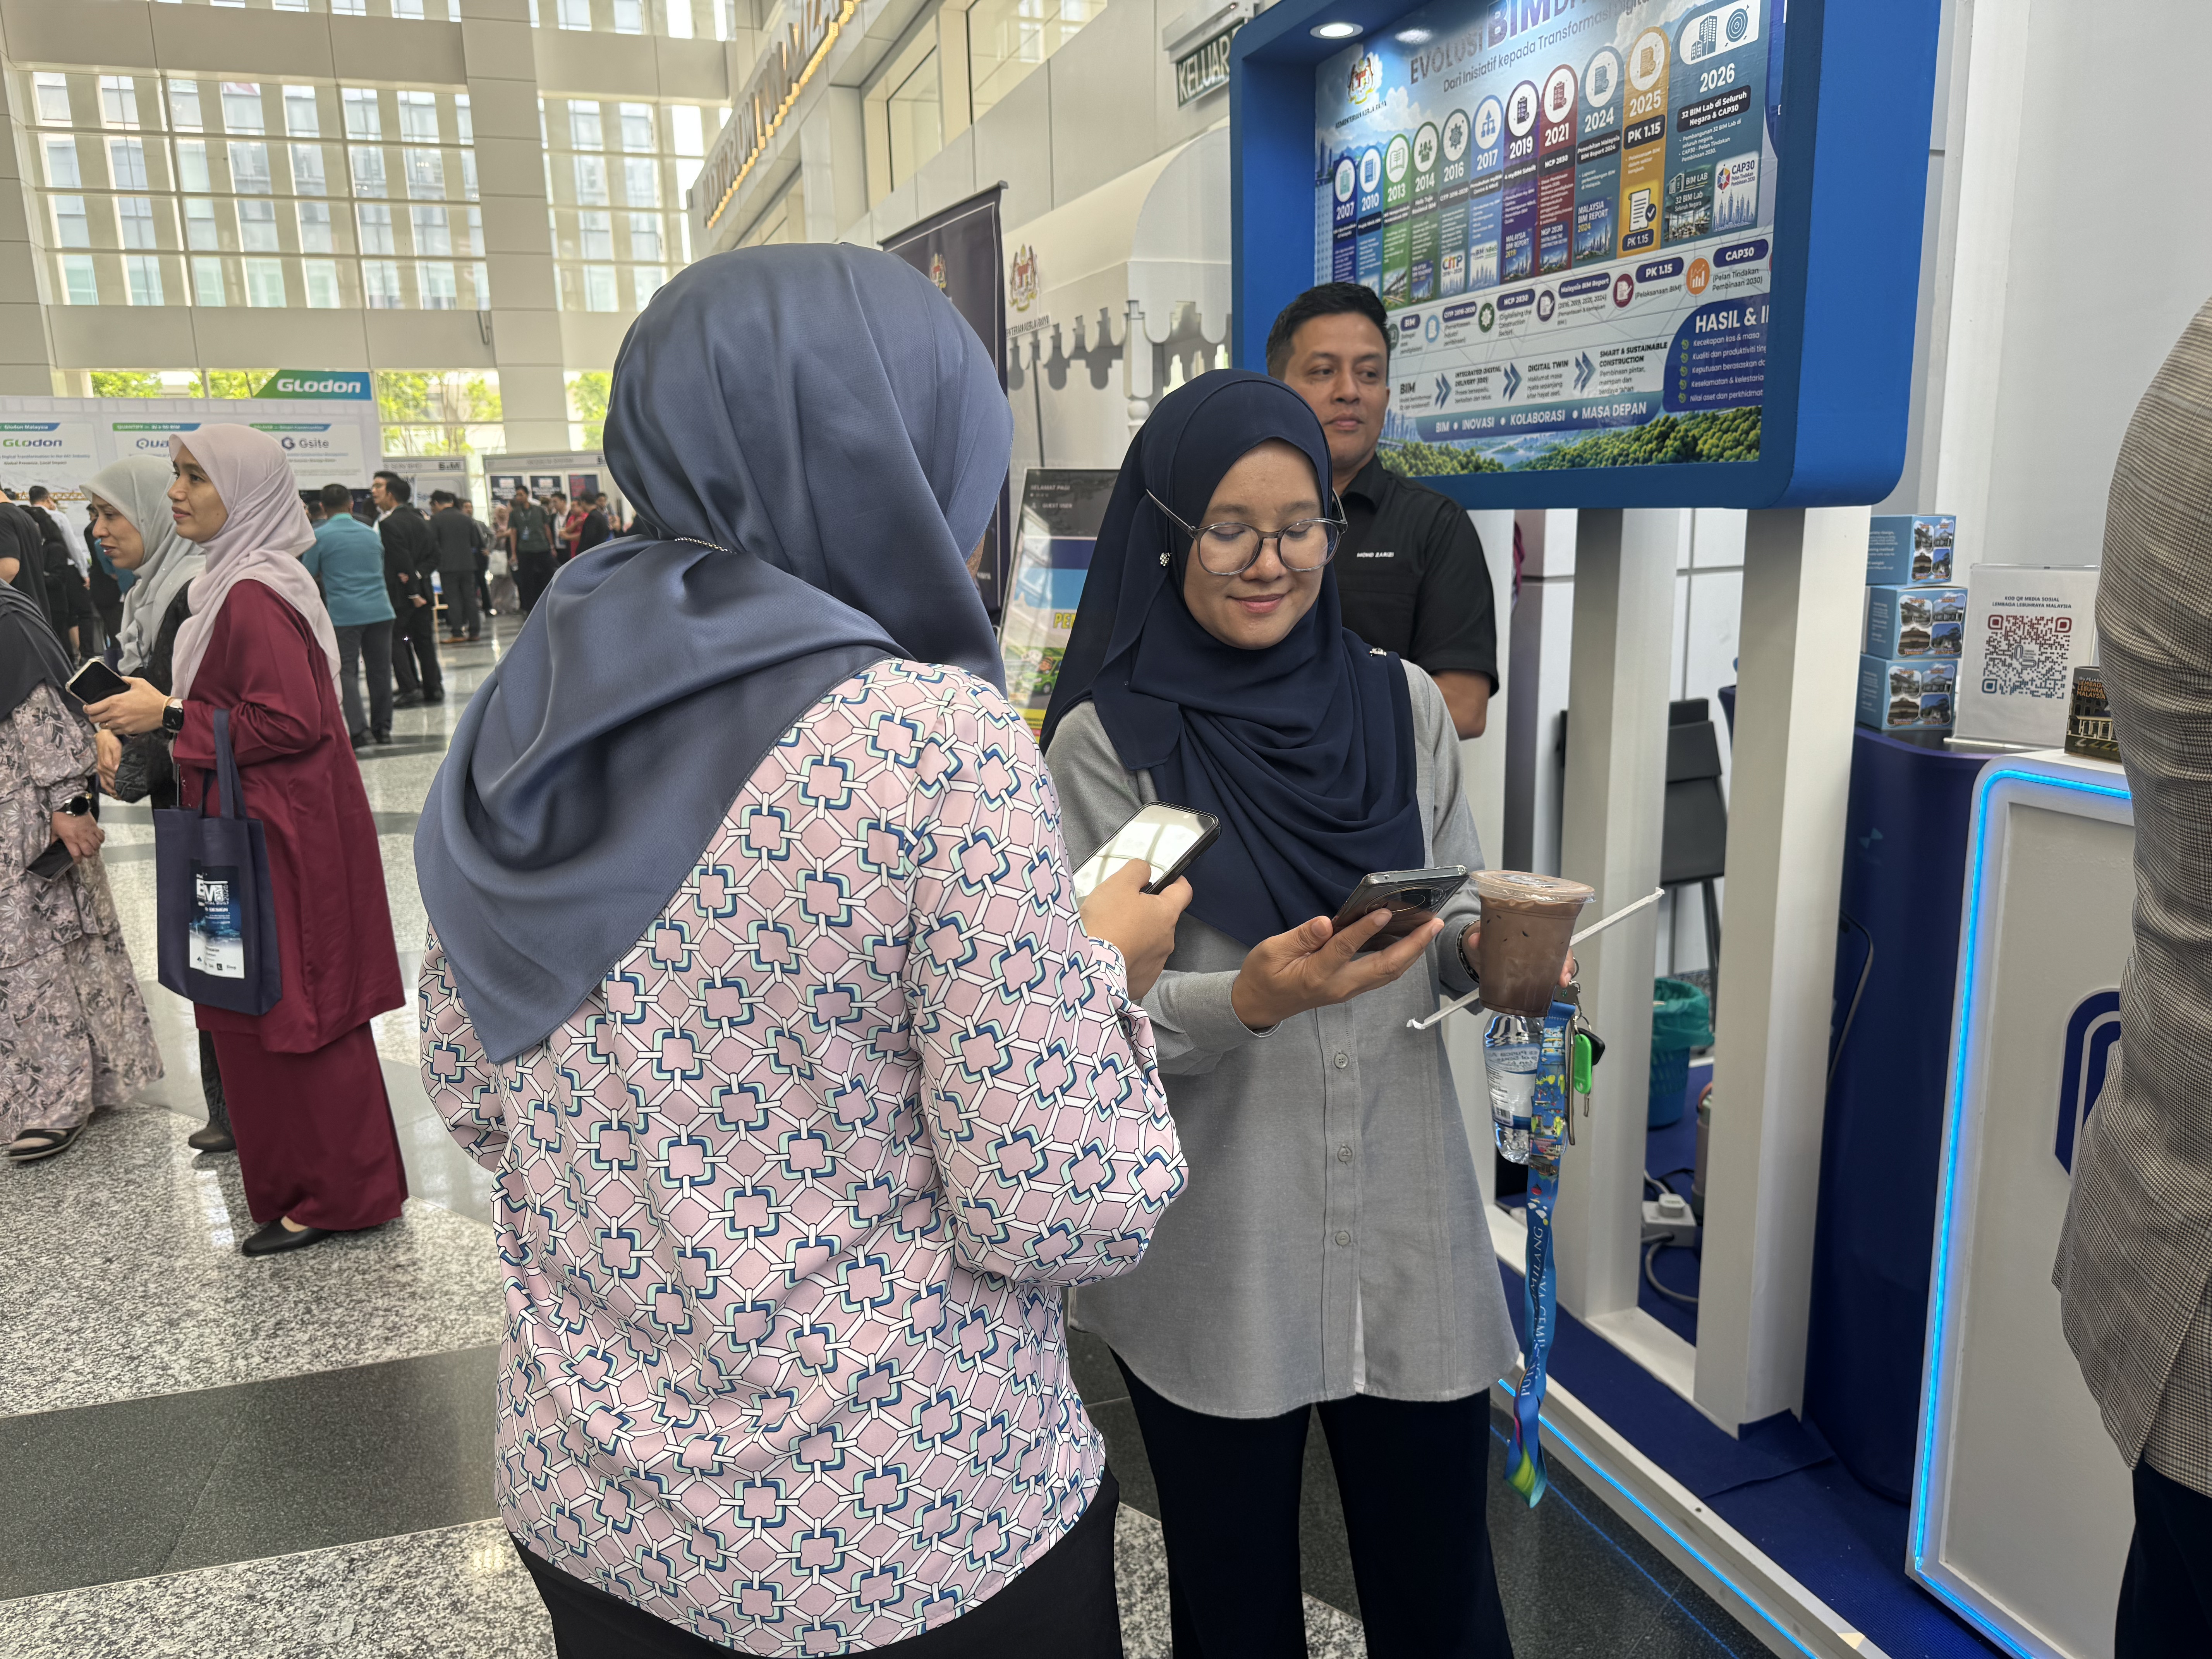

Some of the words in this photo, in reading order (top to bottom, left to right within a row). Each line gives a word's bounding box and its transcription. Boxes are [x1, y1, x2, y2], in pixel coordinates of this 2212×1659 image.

[1410, 26, 1483, 84] EVOLUSI
[1443, 72, 1462, 93] Dari
[1463, 55, 1496, 84] Inisiatif
[1498, 41, 1535, 68] kepada
[1538, 8, 1611, 50] Transformasi
[1178, 35, 1230, 102] KELUAR
[1700, 63, 1735, 93] 2026
[1630, 89, 1661, 117] 2025
[1681, 111, 1688, 119] 32
[1690, 106, 1701, 117] BIM
[1702, 102, 1713, 112] Lab
[1715, 99, 1721, 107] di
[1723, 91, 1747, 105] Seluruh
[1584, 107, 1614, 133] 2024
[1689, 115, 1711, 126] Negara
[1718, 104, 1739, 117] CAP30
[1545, 123, 1569, 147] 2021
[1628, 127, 1642, 143] PK
[1644, 122, 1661, 138] 1.15
[1510, 136, 1533, 159] 2019
[1477, 149, 1498, 171] 2017
[1731, 160, 1755, 175] CAP30
[1444, 161, 1464, 182] 2016
[1686, 175, 1696, 185] BIM
[1697, 172, 1708, 181] LAB
[1415, 172, 1435, 192] 2014
[1362, 192, 1379, 211] 2010
[1387, 183, 1406, 202] 2013
[1683, 193, 1693, 203] BIM
[1336, 201, 1355, 221] 2007
[1578, 201, 1604, 215] MALAYSIA
[1578, 215, 1588, 224] BIM
[1589, 208, 1609, 222] REPORT
[1627, 235, 1636, 247] PK
[1637, 234, 1649, 245] 1.15
[1442, 254, 1463, 270] CITP
[1725, 247, 1754, 261] CAP30
[1645, 266, 1657, 278] PK
[1659, 263, 1673, 275] 1.15
[1712, 272, 1731, 283] (Pelan
[1733, 268, 1759, 278] Tindakan
[1712, 280, 1745, 291] Pembinaan
[1746, 276, 1762, 285] 2030)
[1695, 310, 1740, 333] HASIL
[1744, 307, 1757, 326] &
[1600, 348, 1620, 358] SMART
[1626, 342, 1668, 354] SUSTAINABLE
[1528, 361, 1551, 373] DIGITAL
[1552, 360, 1568, 369] TWIN
[1599, 356, 1645, 368] CONSTRUCTION
[1400, 381, 1416, 395] BIM
[1436, 421, 1449, 433] BIM
[1462, 416, 1495, 431] INOVASI
[1510, 409, 1566, 426] KOLABORASI
[1582, 406, 1610, 419] MASA
[1612, 402, 1647, 416] DEPAN
